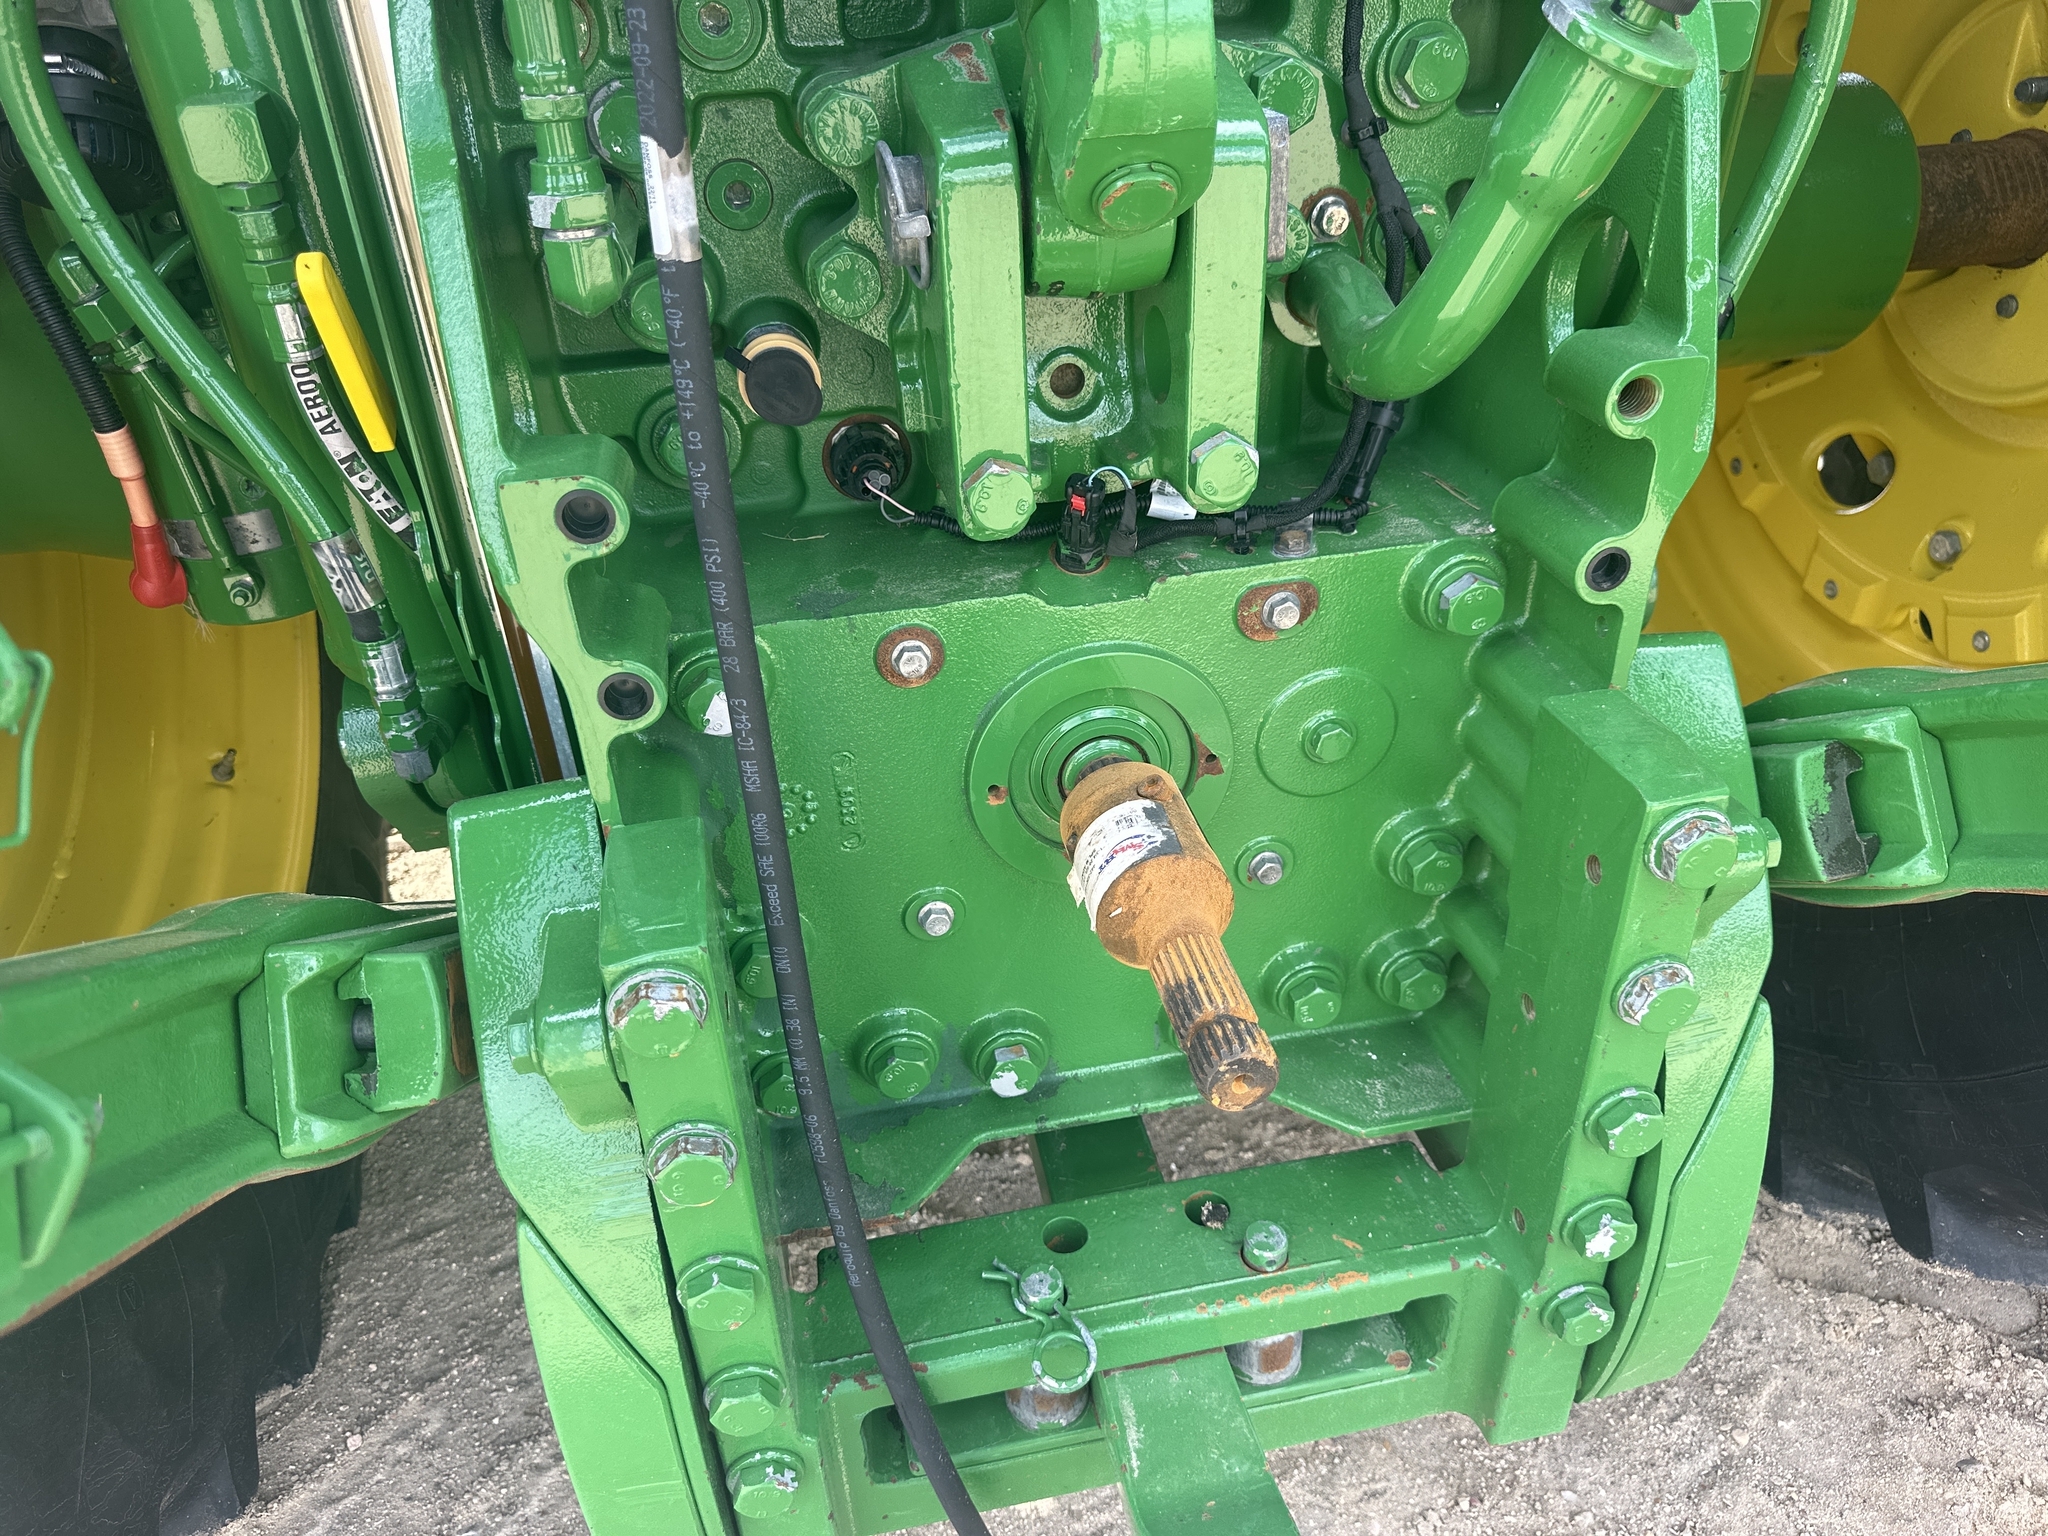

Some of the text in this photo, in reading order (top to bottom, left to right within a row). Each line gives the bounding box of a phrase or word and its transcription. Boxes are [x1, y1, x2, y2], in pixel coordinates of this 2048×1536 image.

[627, 7, 657, 128] 2022-09-23
[644, 141, 654, 178] DANFOSS
[661, 284, 687, 348] (-40°F
[672, 358, 697, 420] +149°C
[687, 431, 703, 450] to
[688, 461, 711, 509] -40°C
[703, 538, 723, 572] PSI)
[710, 581, 730, 613] (400
[717, 621, 737, 647] BAR
[723, 656, 740, 674] 28
[731, 698, 755, 752] IC-84/3
[741, 759, 762, 792] MSHA
[750, 812, 771, 847] 100R6
[757, 854, 775, 877] SAE
[762, 884, 785, 927] Exceed
[773, 946, 792, 974] DN10
[788, 1018, 806, 1051] (0.38
[793, 1056, 808, 1072] MM
[798, 1075, 813, 1096] 9.5
[803, 1114, 829, 1164] FC598-06
[822, 1179, 842, 1220] Danfoss
[833, 1224, 847, 1238] by
[838, 1241, 862, 1287] Aeroquip
